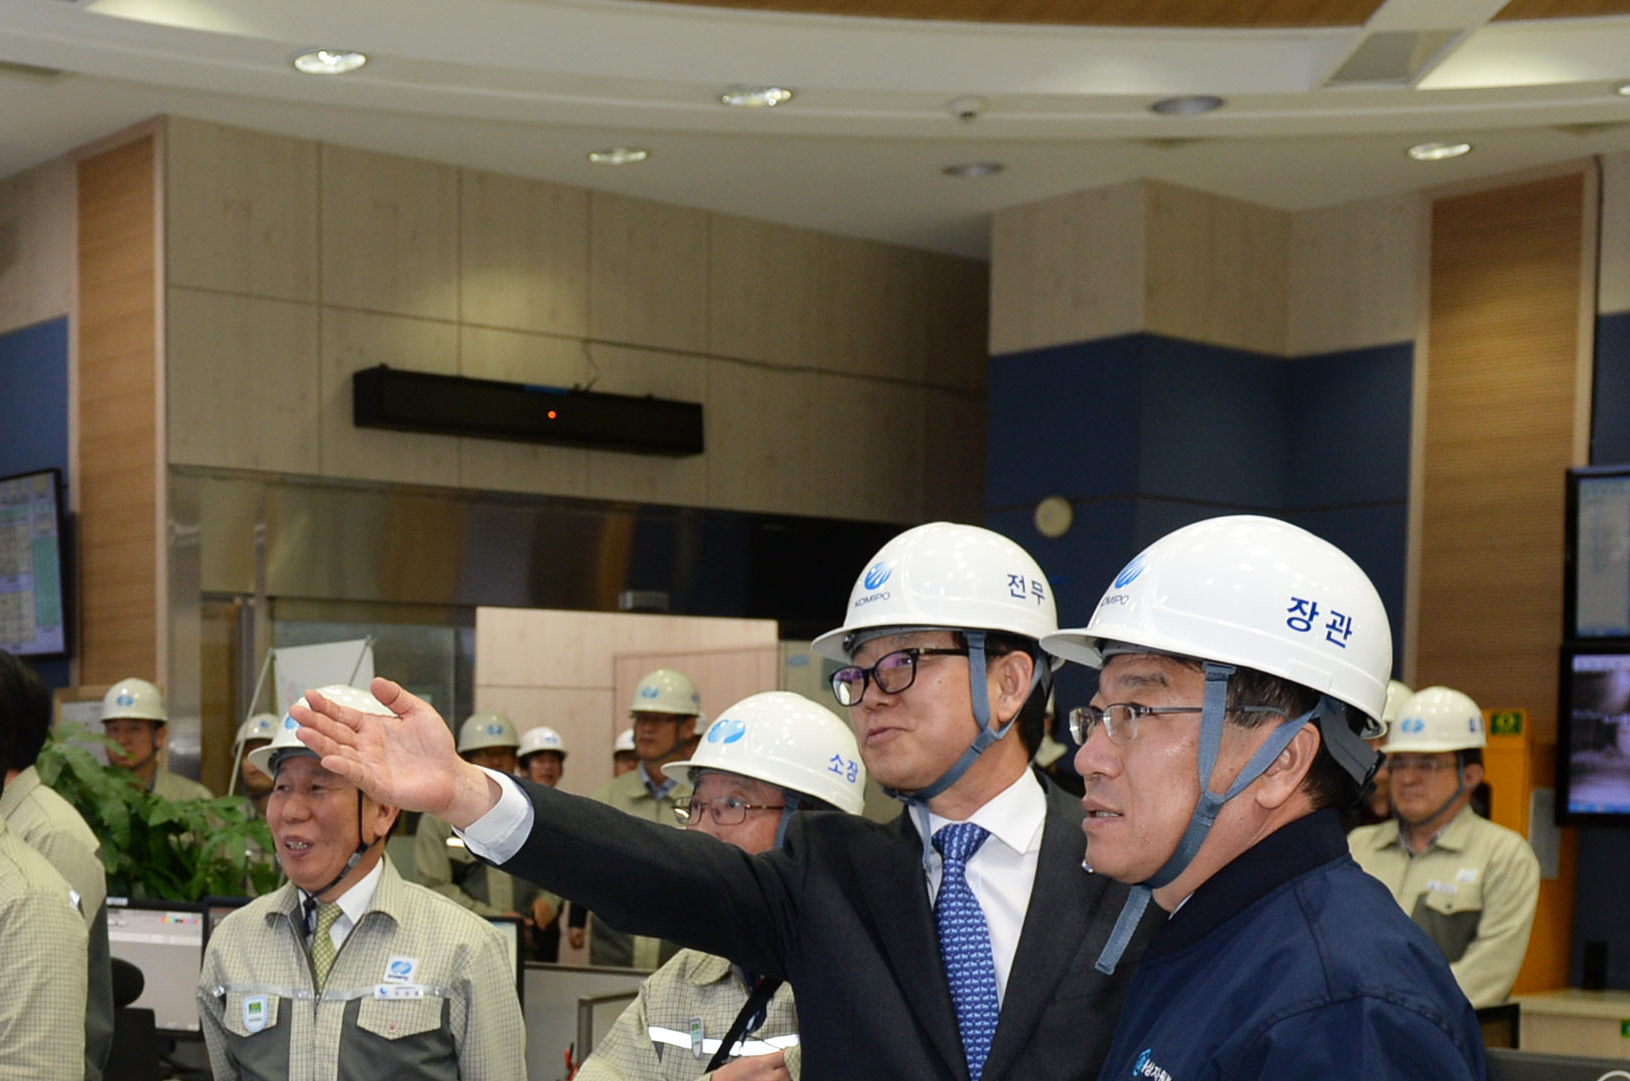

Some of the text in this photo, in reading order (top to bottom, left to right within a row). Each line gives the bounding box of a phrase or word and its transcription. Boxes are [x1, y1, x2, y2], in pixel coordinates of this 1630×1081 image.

[854, 591, 891, 608] KOMIPO
[1007, 573, 1045, 606] 전무
[1286, 596, 1353, 649] 장관
[828, 753, 859, 784] 소장
